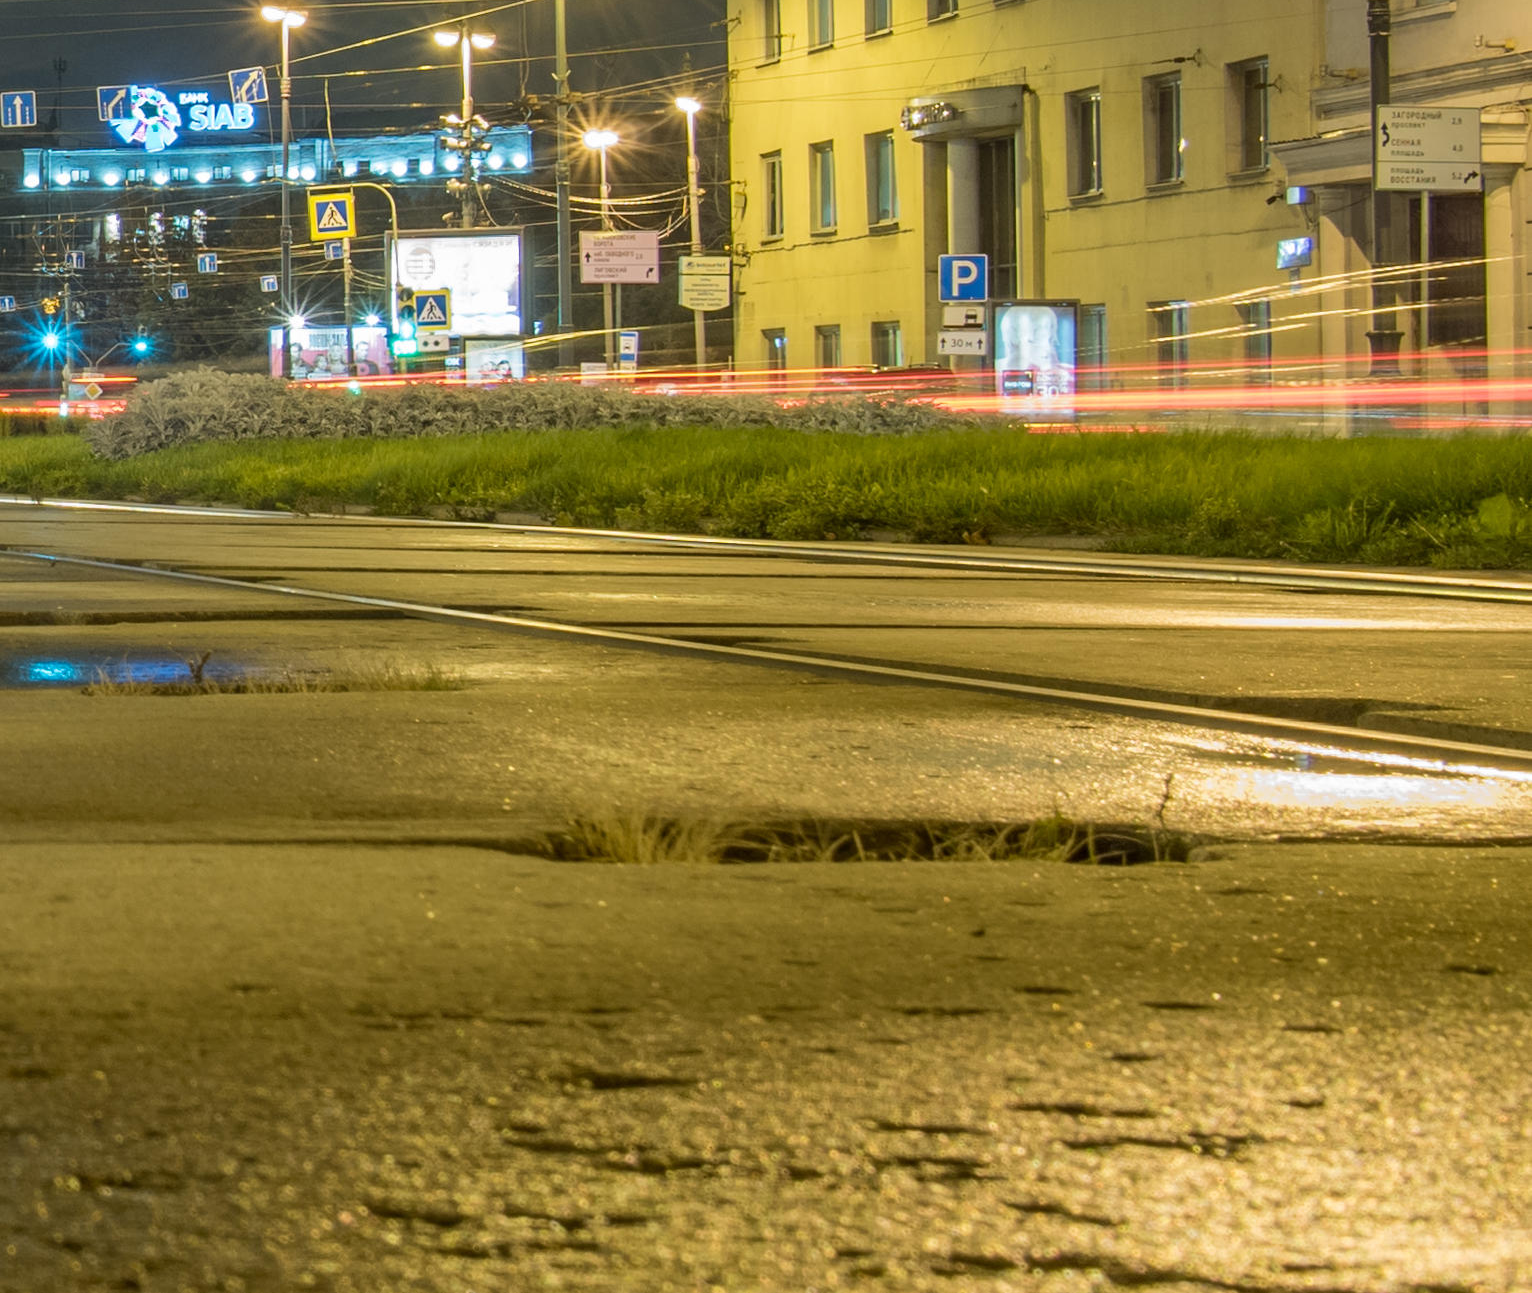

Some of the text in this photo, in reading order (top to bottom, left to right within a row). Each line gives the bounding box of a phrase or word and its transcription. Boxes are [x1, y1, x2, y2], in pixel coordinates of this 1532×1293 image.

[189, 103, 254, 130] SIAB
[952, 260, 978, 297] P
[951, 338, 963, 348] 30
